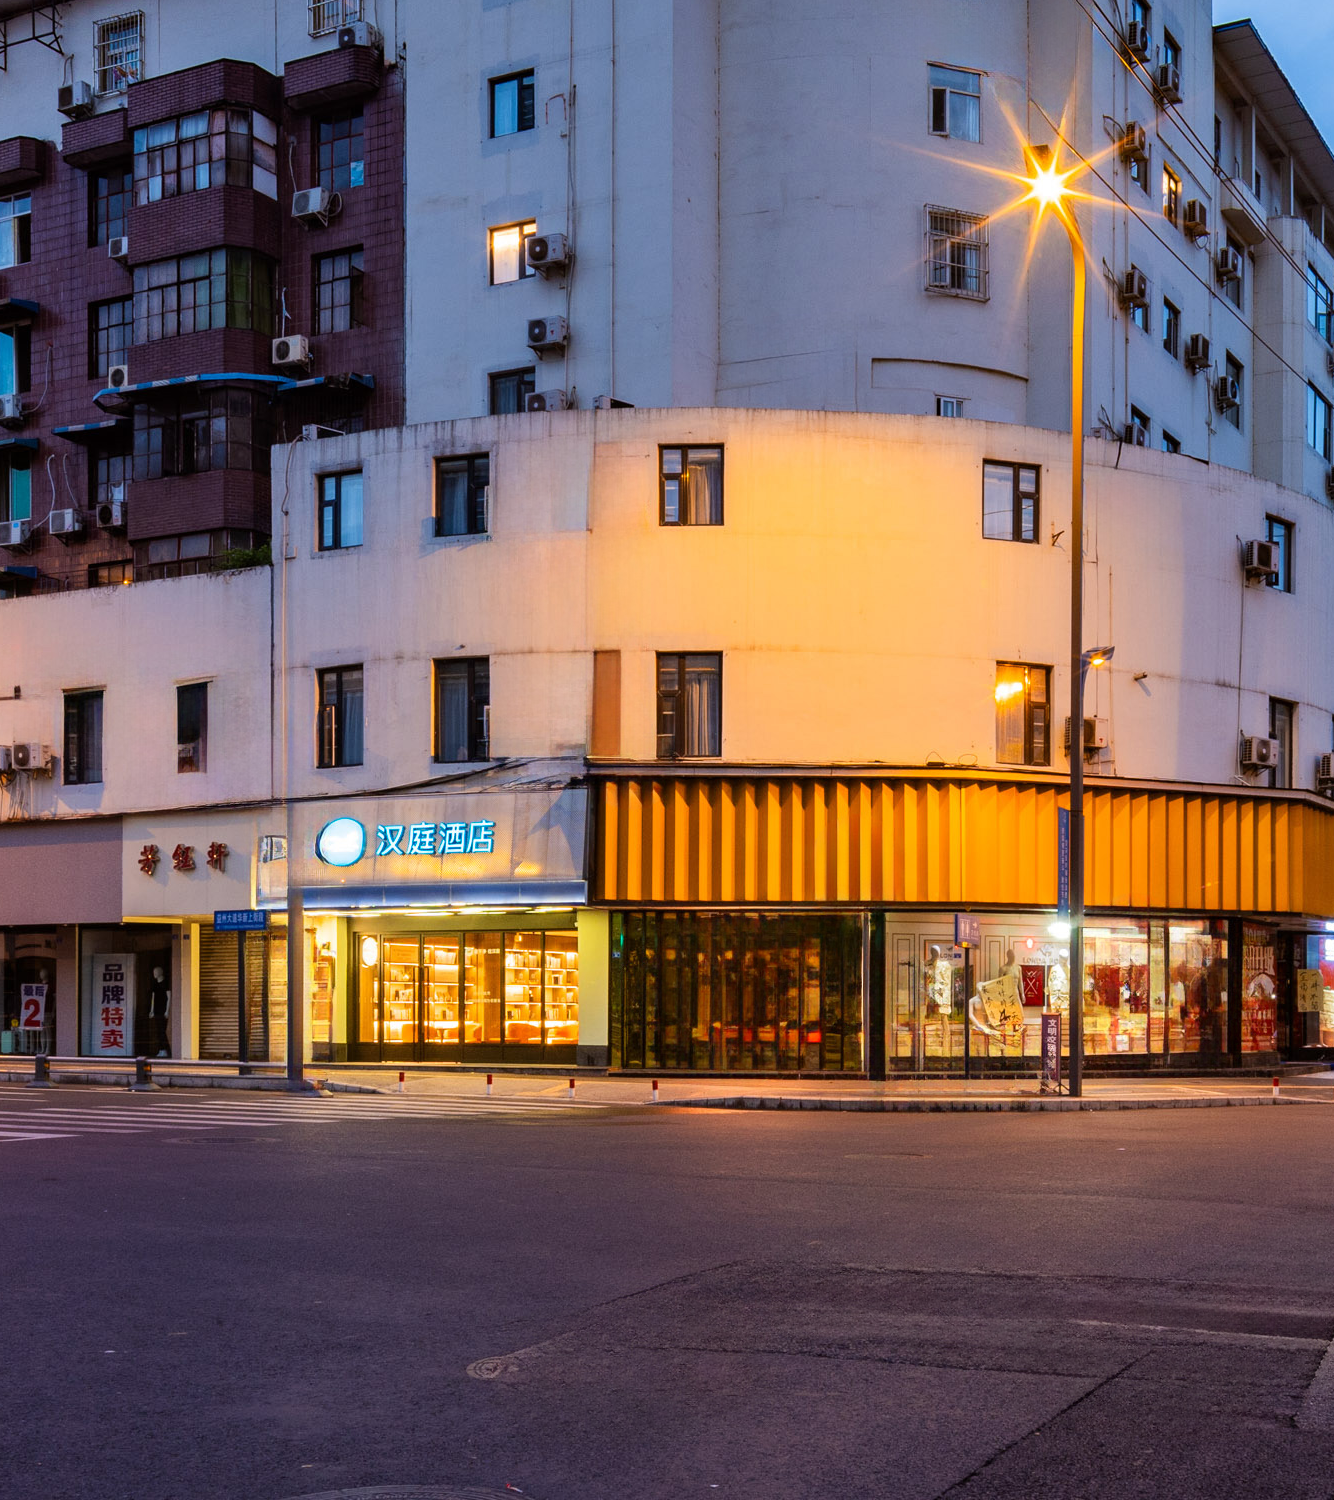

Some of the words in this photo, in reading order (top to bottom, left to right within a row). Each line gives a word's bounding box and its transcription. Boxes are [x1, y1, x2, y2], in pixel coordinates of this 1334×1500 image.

[376, 820, 494, 856] 汉庭酒店
[23, 985, 45, 997] 最后
[101, 963, 125, 1049] 品牌特卖
[23, 998, 41, 1027] 2
